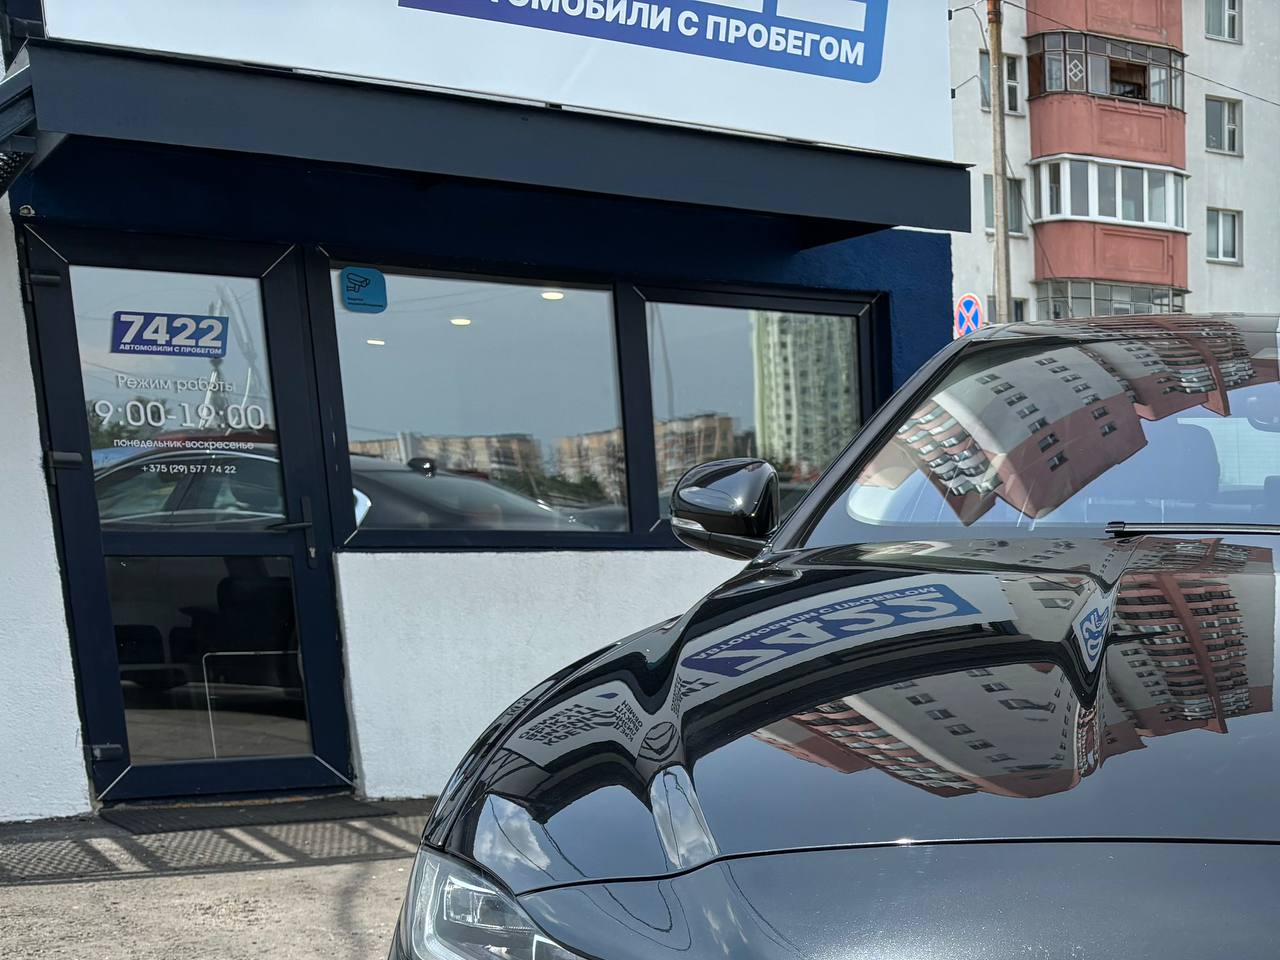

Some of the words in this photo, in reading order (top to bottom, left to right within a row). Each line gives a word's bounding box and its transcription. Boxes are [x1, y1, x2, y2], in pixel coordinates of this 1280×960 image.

[677, 10, 699, 36] С
[706, 14, 865, 66] ПРОБЕГОМ
[120, 314, 223, 347] 7422
[120, 344, 173, 352] АВТОМОБИЛИ
[181, 346, 222, 354] ПРОБЕГОМ
[117, 374, 170, 390] Режим
[142, 463, 168, 473] +375
[190, 464, 207, 473] 577
[210, 465, 222, 473] 74
[224, 465, 237, 474] 22
